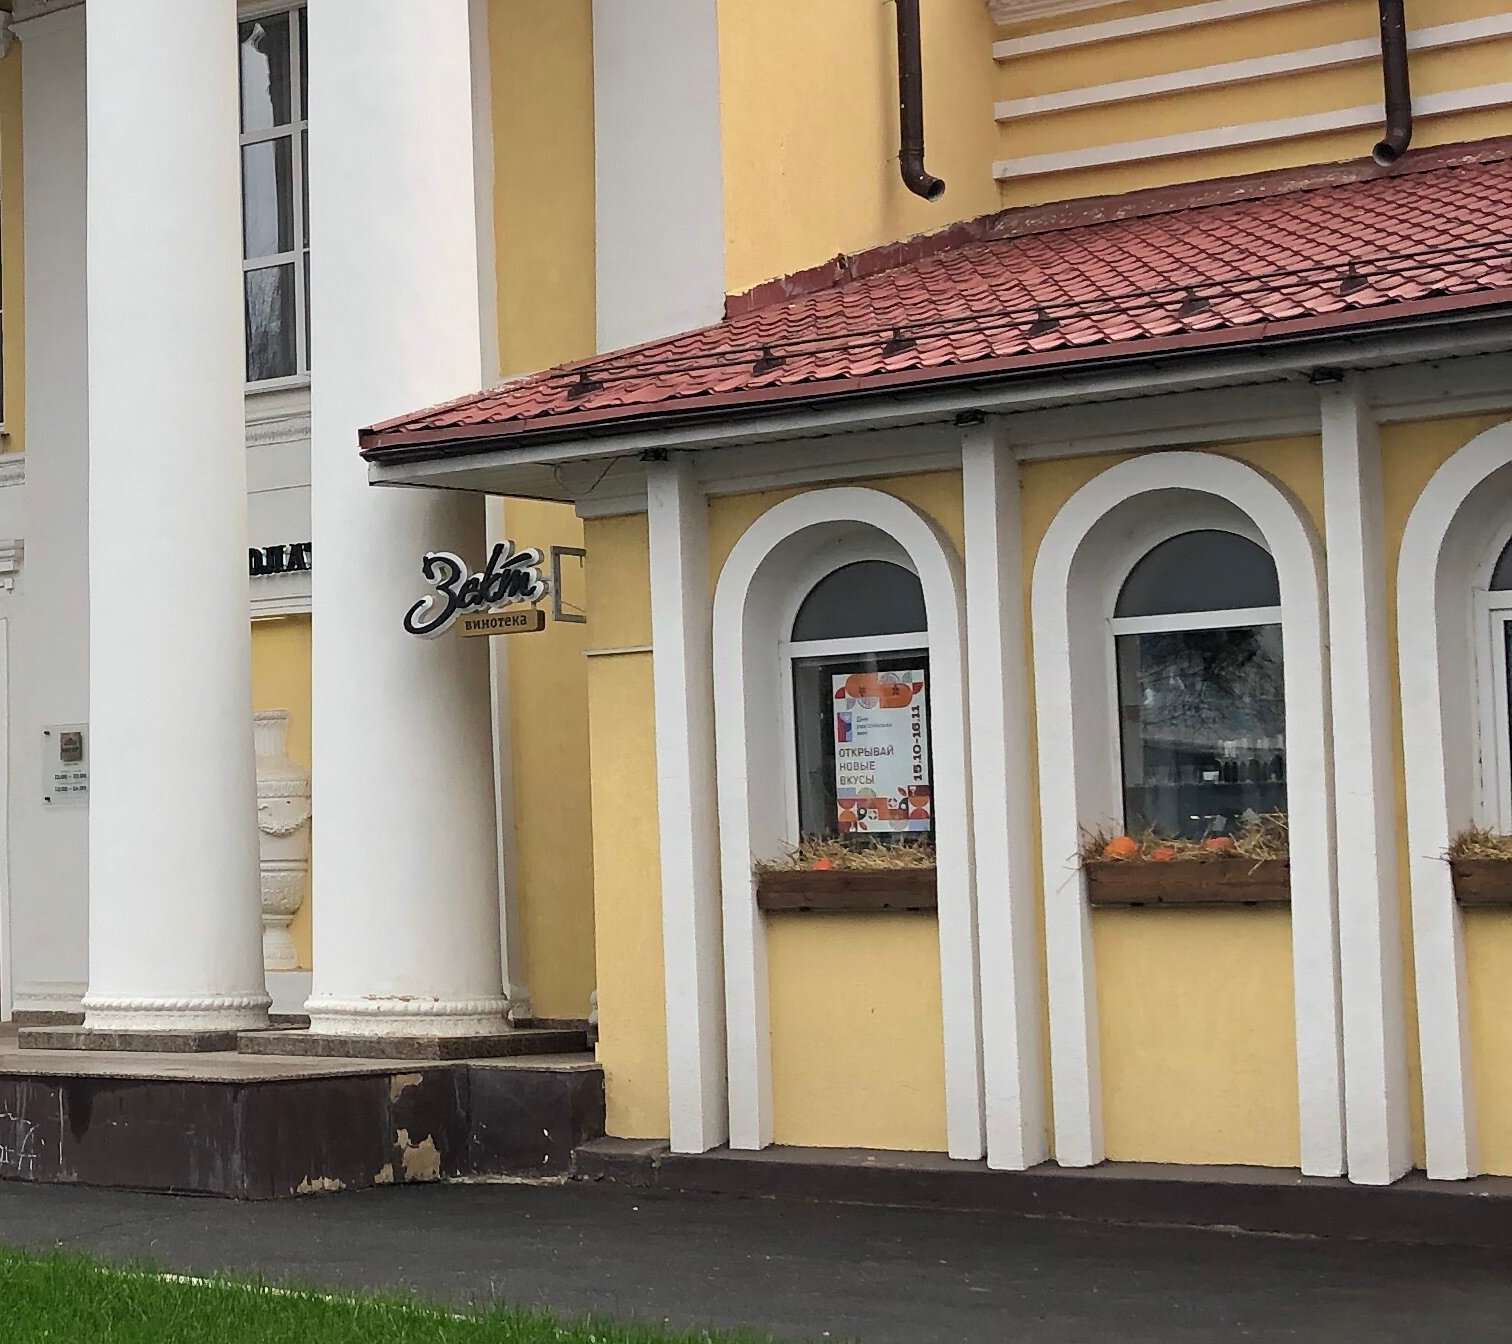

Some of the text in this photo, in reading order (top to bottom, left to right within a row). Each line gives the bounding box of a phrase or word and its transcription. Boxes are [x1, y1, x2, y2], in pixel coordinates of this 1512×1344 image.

[464, 613, 528, 631] винотека
[911, 705, 923, 781] 15.10-16.11
[838, 744, 894, 758] ОТКРЫВАЙ
[839, 760, 876, 772] НОВЫЕ
[839, 774, 875, 786] ВКУСЫ
